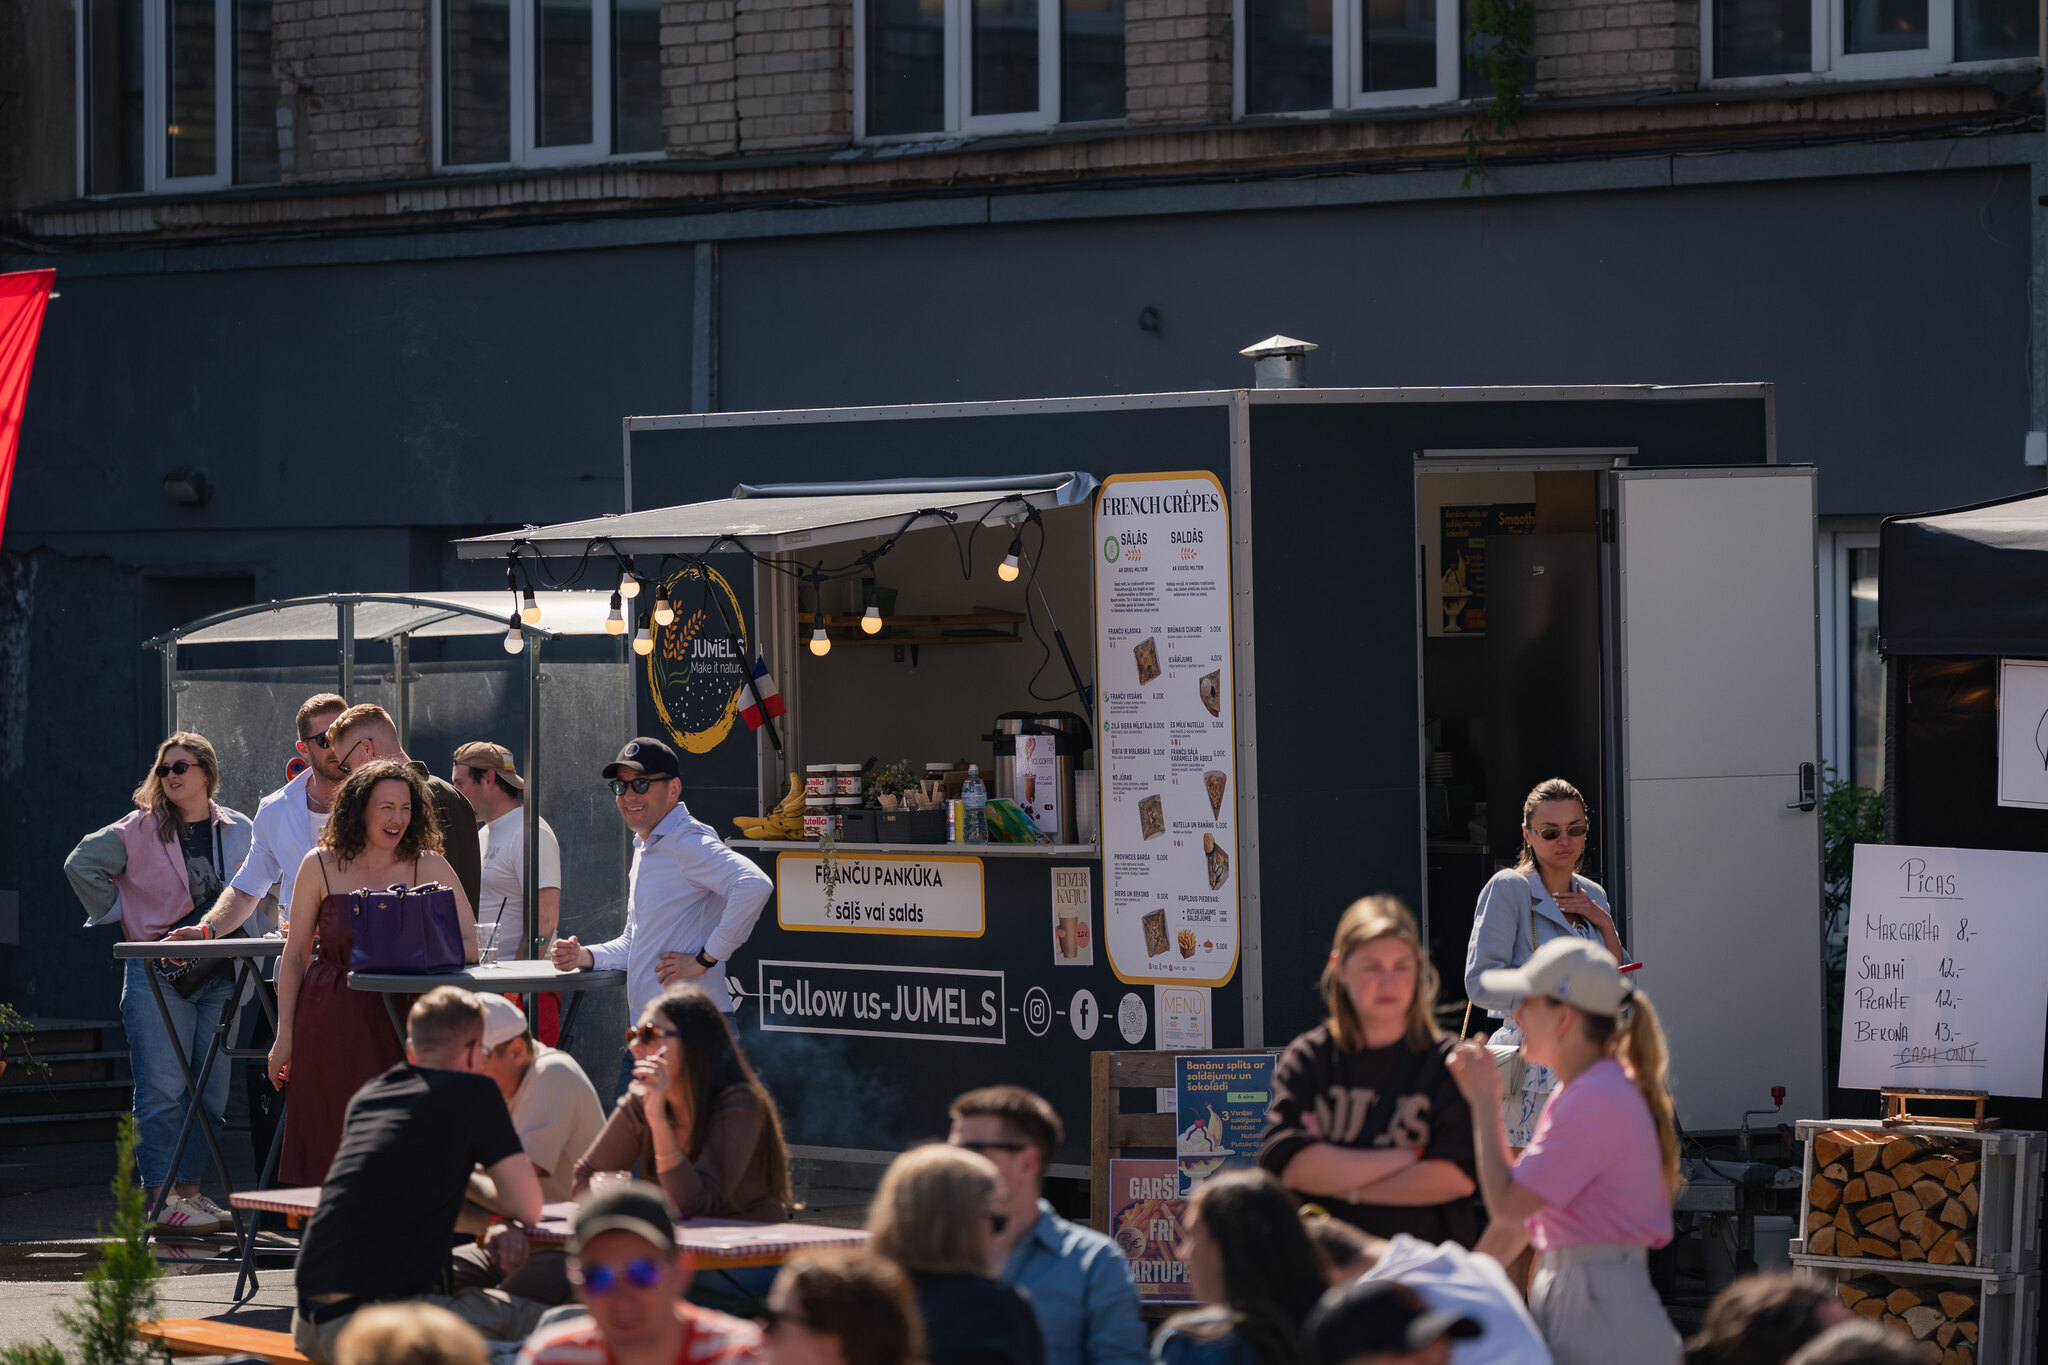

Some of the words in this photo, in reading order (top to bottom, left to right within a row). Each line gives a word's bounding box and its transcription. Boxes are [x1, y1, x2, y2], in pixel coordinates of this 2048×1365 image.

[1103, 496, 1160, 515] FRENCH
[1163, 490, 1219, 513] CRÊPES
[1498, 512, 1536, 526] Smooth
[1121, 530, 1148, 549] SĀĻĀS
[1171, 527, 1203, 544] SALDĀS
[691, 661, 712, 674] Make
[714, 661, 719, 674] it
[806, 817, 827, 825] utella
[815, 861, 871, 885] FRANČU
[875, 864, 943, 888] PANKŪKA
[836, 901, 861, 925] sāļš
[865, 903, 885, 922] vai
[889, 903, 924, 923] salds
[769, 979, 848, 1018] Follow
[1165, 995, 1202, 1015] MENU
[1187, 1061, 1224, 1070] Banānu
[1227, 1060, 1251, 1071] splits
[1187, 1071, 1236, 1082] saldējumu
[1187, 1081, 1228, 1091] šokolādi
[1222, 1111, 1229, 1121] 3
[1129, 1174, 1178, 1200] GARŠĪ
[1150, 1216, 1176, 1241] FRĪ
[1119, 1232, 1143, 1253] 5€
[1128, 1261, 1191, 1283] ARTUPE
